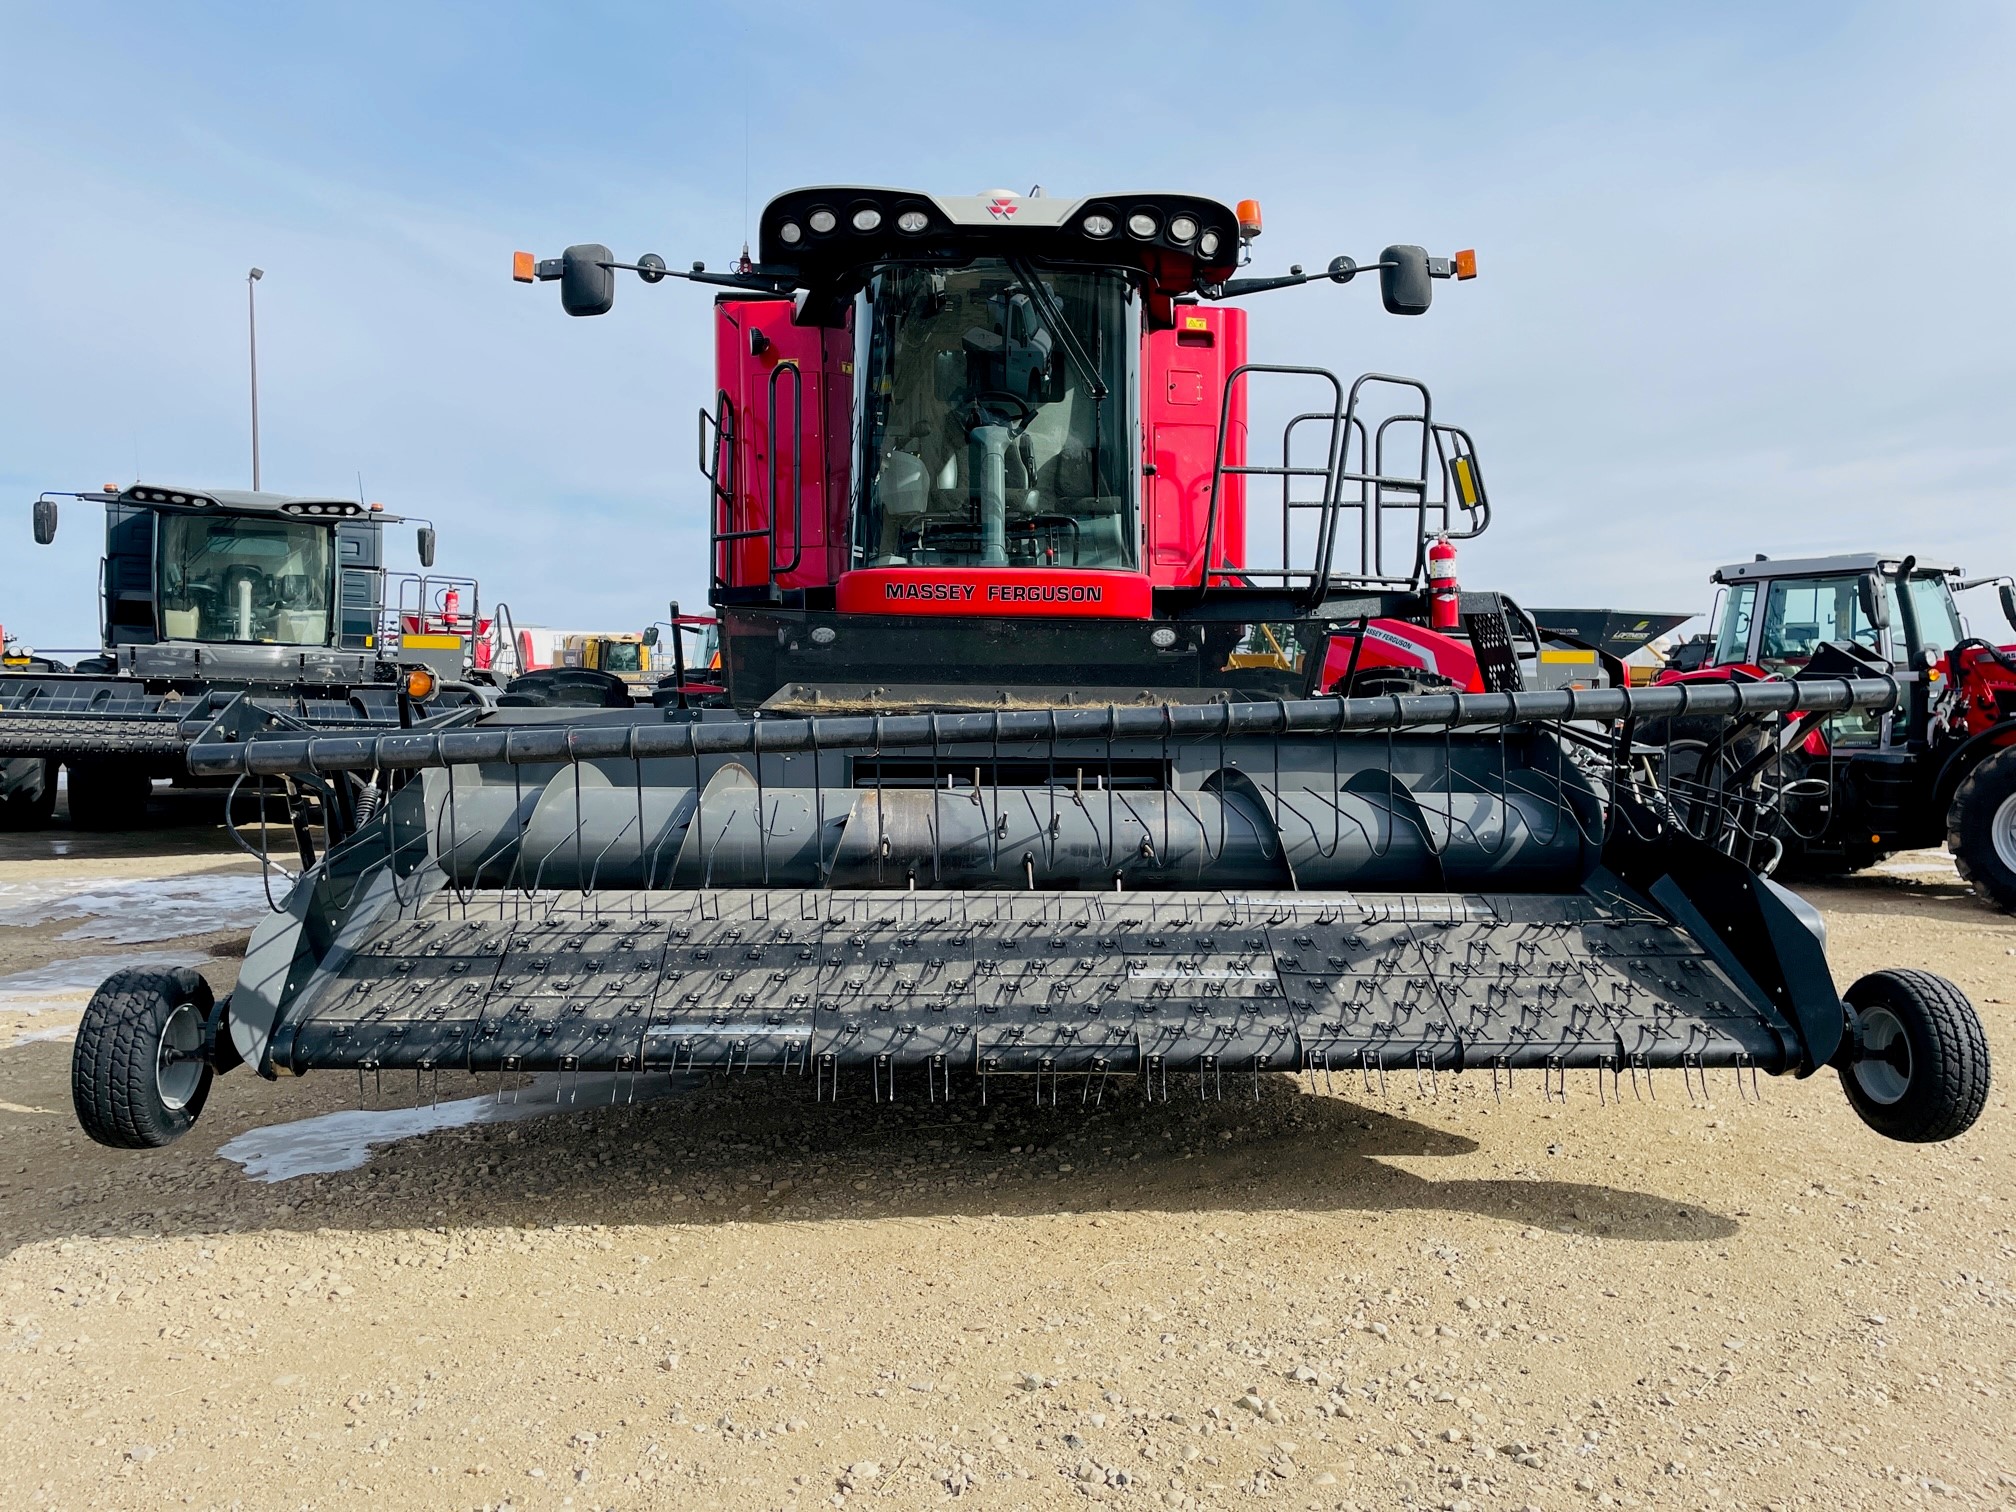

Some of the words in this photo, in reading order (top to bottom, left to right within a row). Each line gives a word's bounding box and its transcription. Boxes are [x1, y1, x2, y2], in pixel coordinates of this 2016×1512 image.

[885, 583, 976, 600] MASSEY
[987, 585, 1102, 602] FERGUSON
[1366, 628, 1383, 638] ASSEY
[1382, 633, 1413, 649] FERGUSON
